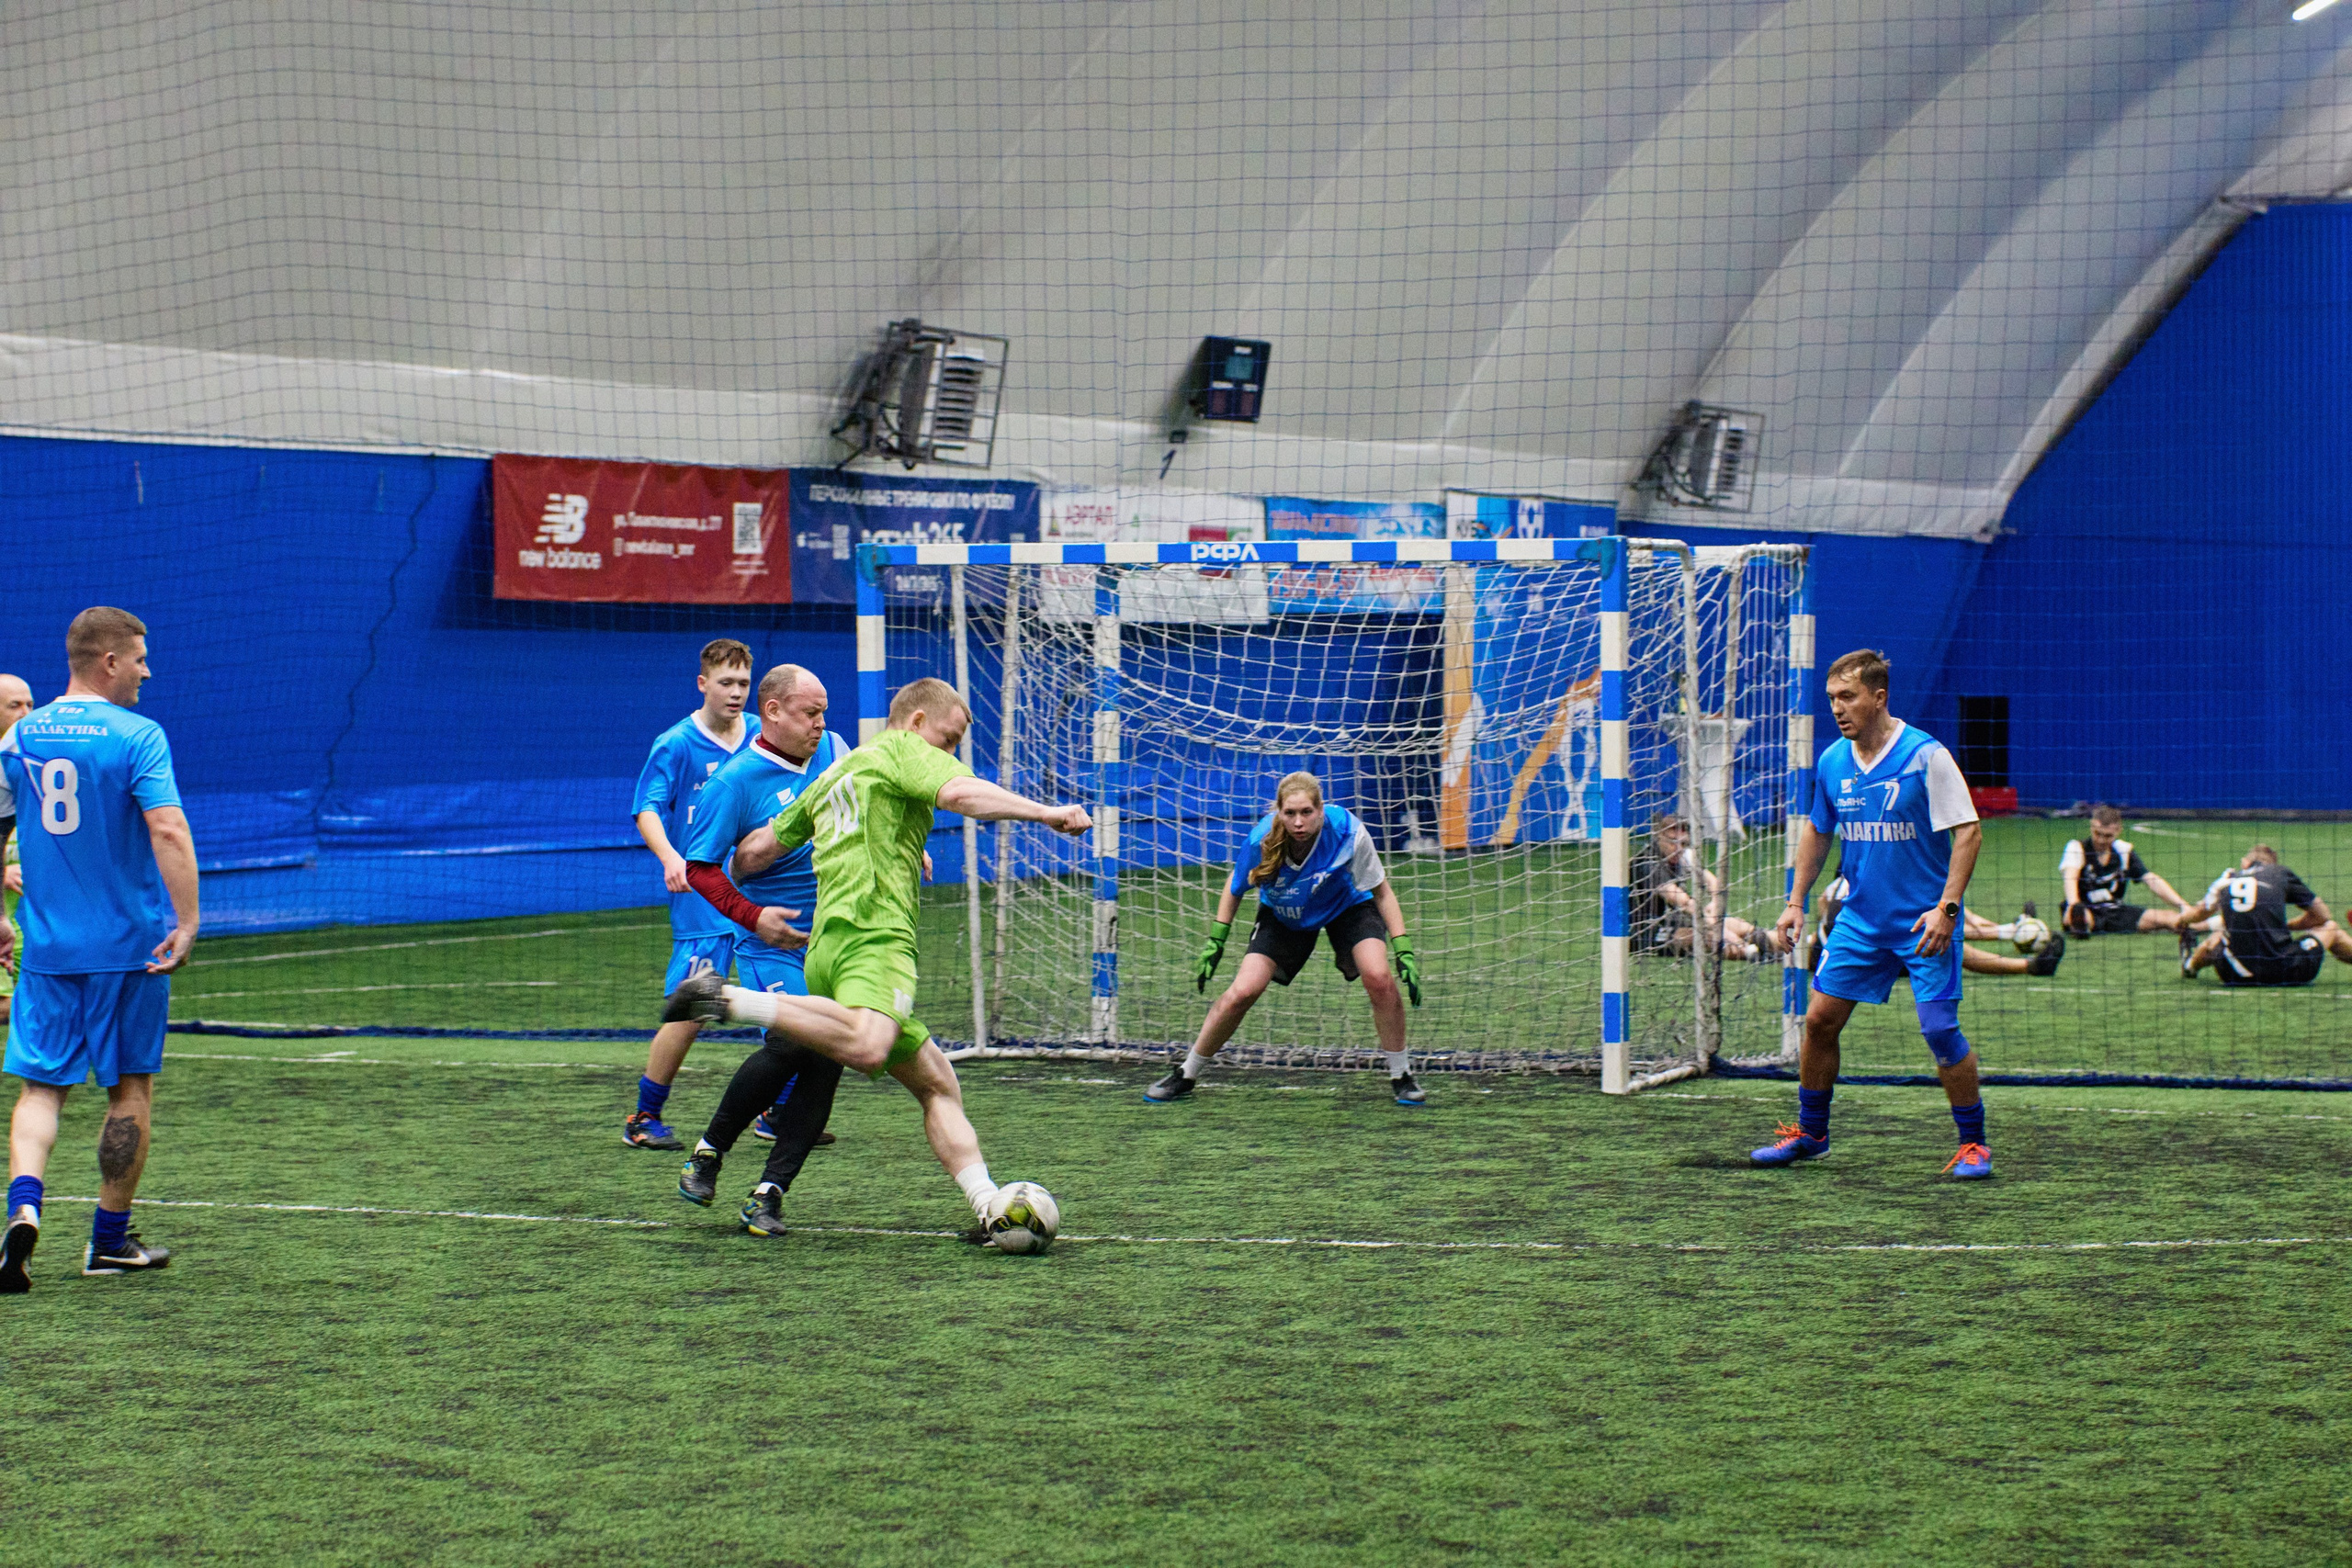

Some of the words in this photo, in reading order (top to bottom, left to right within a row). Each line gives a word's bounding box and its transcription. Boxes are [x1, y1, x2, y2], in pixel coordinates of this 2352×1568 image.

[518, 549, 546, 568] new
[546, 547, 602, 570] balance
[23, 724, 108, 736] ГАЛАКТИКА
[41, 758, 81, 835] 8
[823, 773, 860, 844] 10
[1884, 781, 1900, 810] 7
[2229, 876, 2257, 912] 9
